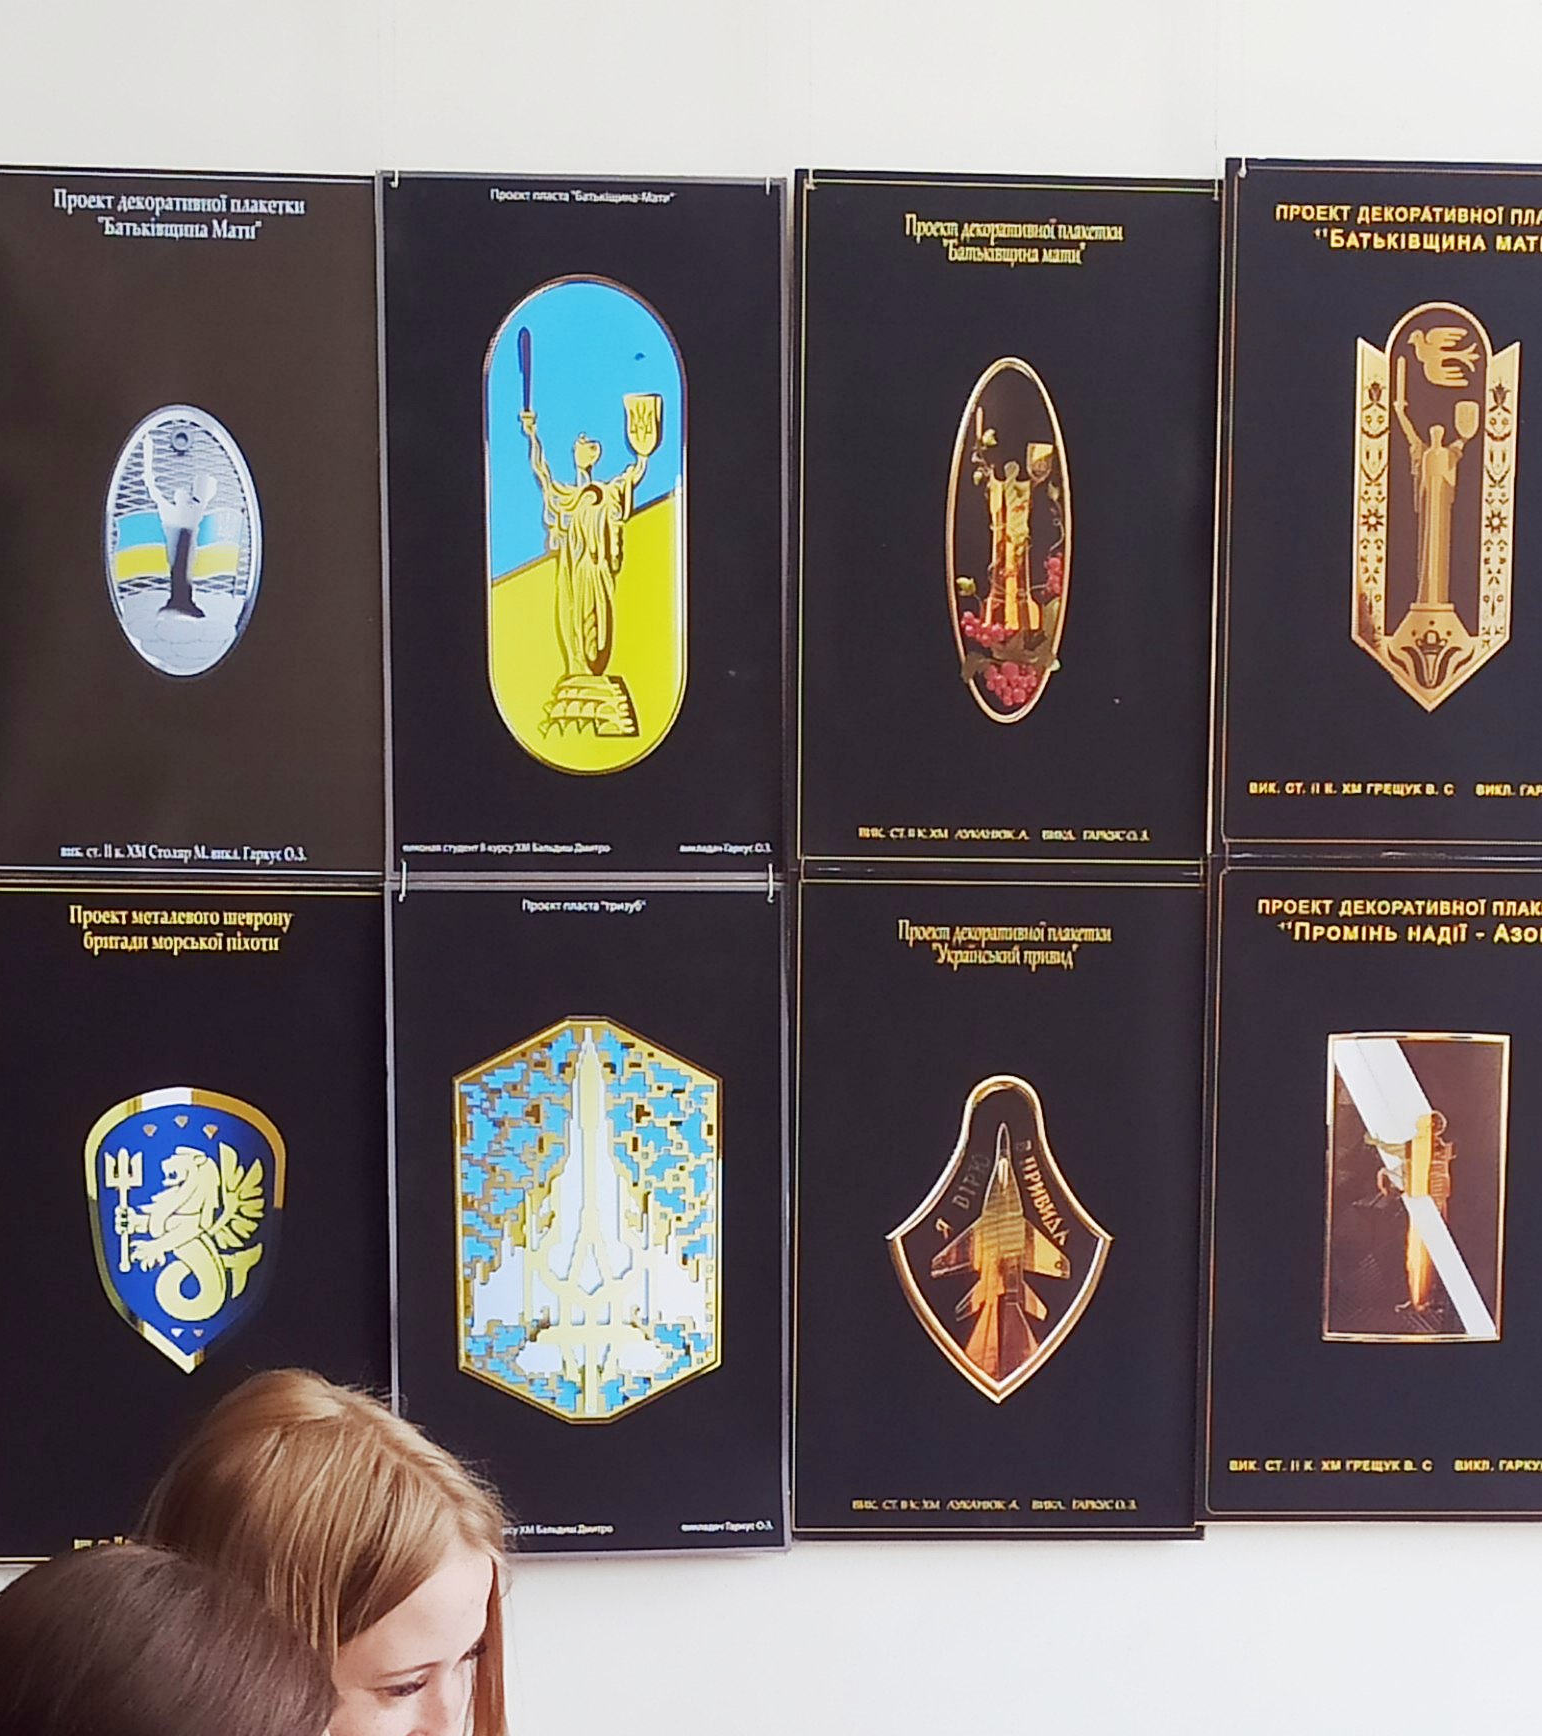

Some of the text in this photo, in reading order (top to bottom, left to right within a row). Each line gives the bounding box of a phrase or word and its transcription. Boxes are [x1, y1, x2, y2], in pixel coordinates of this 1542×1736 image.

[117, 193, 228, 217] декоративної
[230, 197, 306, 215] плакетки
[1274, 203, 1352, 222] ПРОЕКТ
[1356, 204, 1504, 226] ДЕКОРАТИВНОЇ
[960, 216, 1056, 246] декоративної
[1057, 225, 1124, 241] плакетки
[1365, 783, 1423, 797] ГРЕЩУК
[1257, 898, 1334, 915] ПРОЕКТ
[1338, 898, 1487, 919] ДЕКОРАТИВНОЇ
[130, 910, 220, 926] металевого
[221, 911, 295, 934] шеврону
[952, 920, 1046, 948] декоративної
[1047, 926, 1113, 942] плакетки
[83, 930, 281, 956] бригади морської піхоти
[1320, 1459, 1342, 1473] ХМ
[1345, 1459, 1401, 1474] ГРЕЩУК
